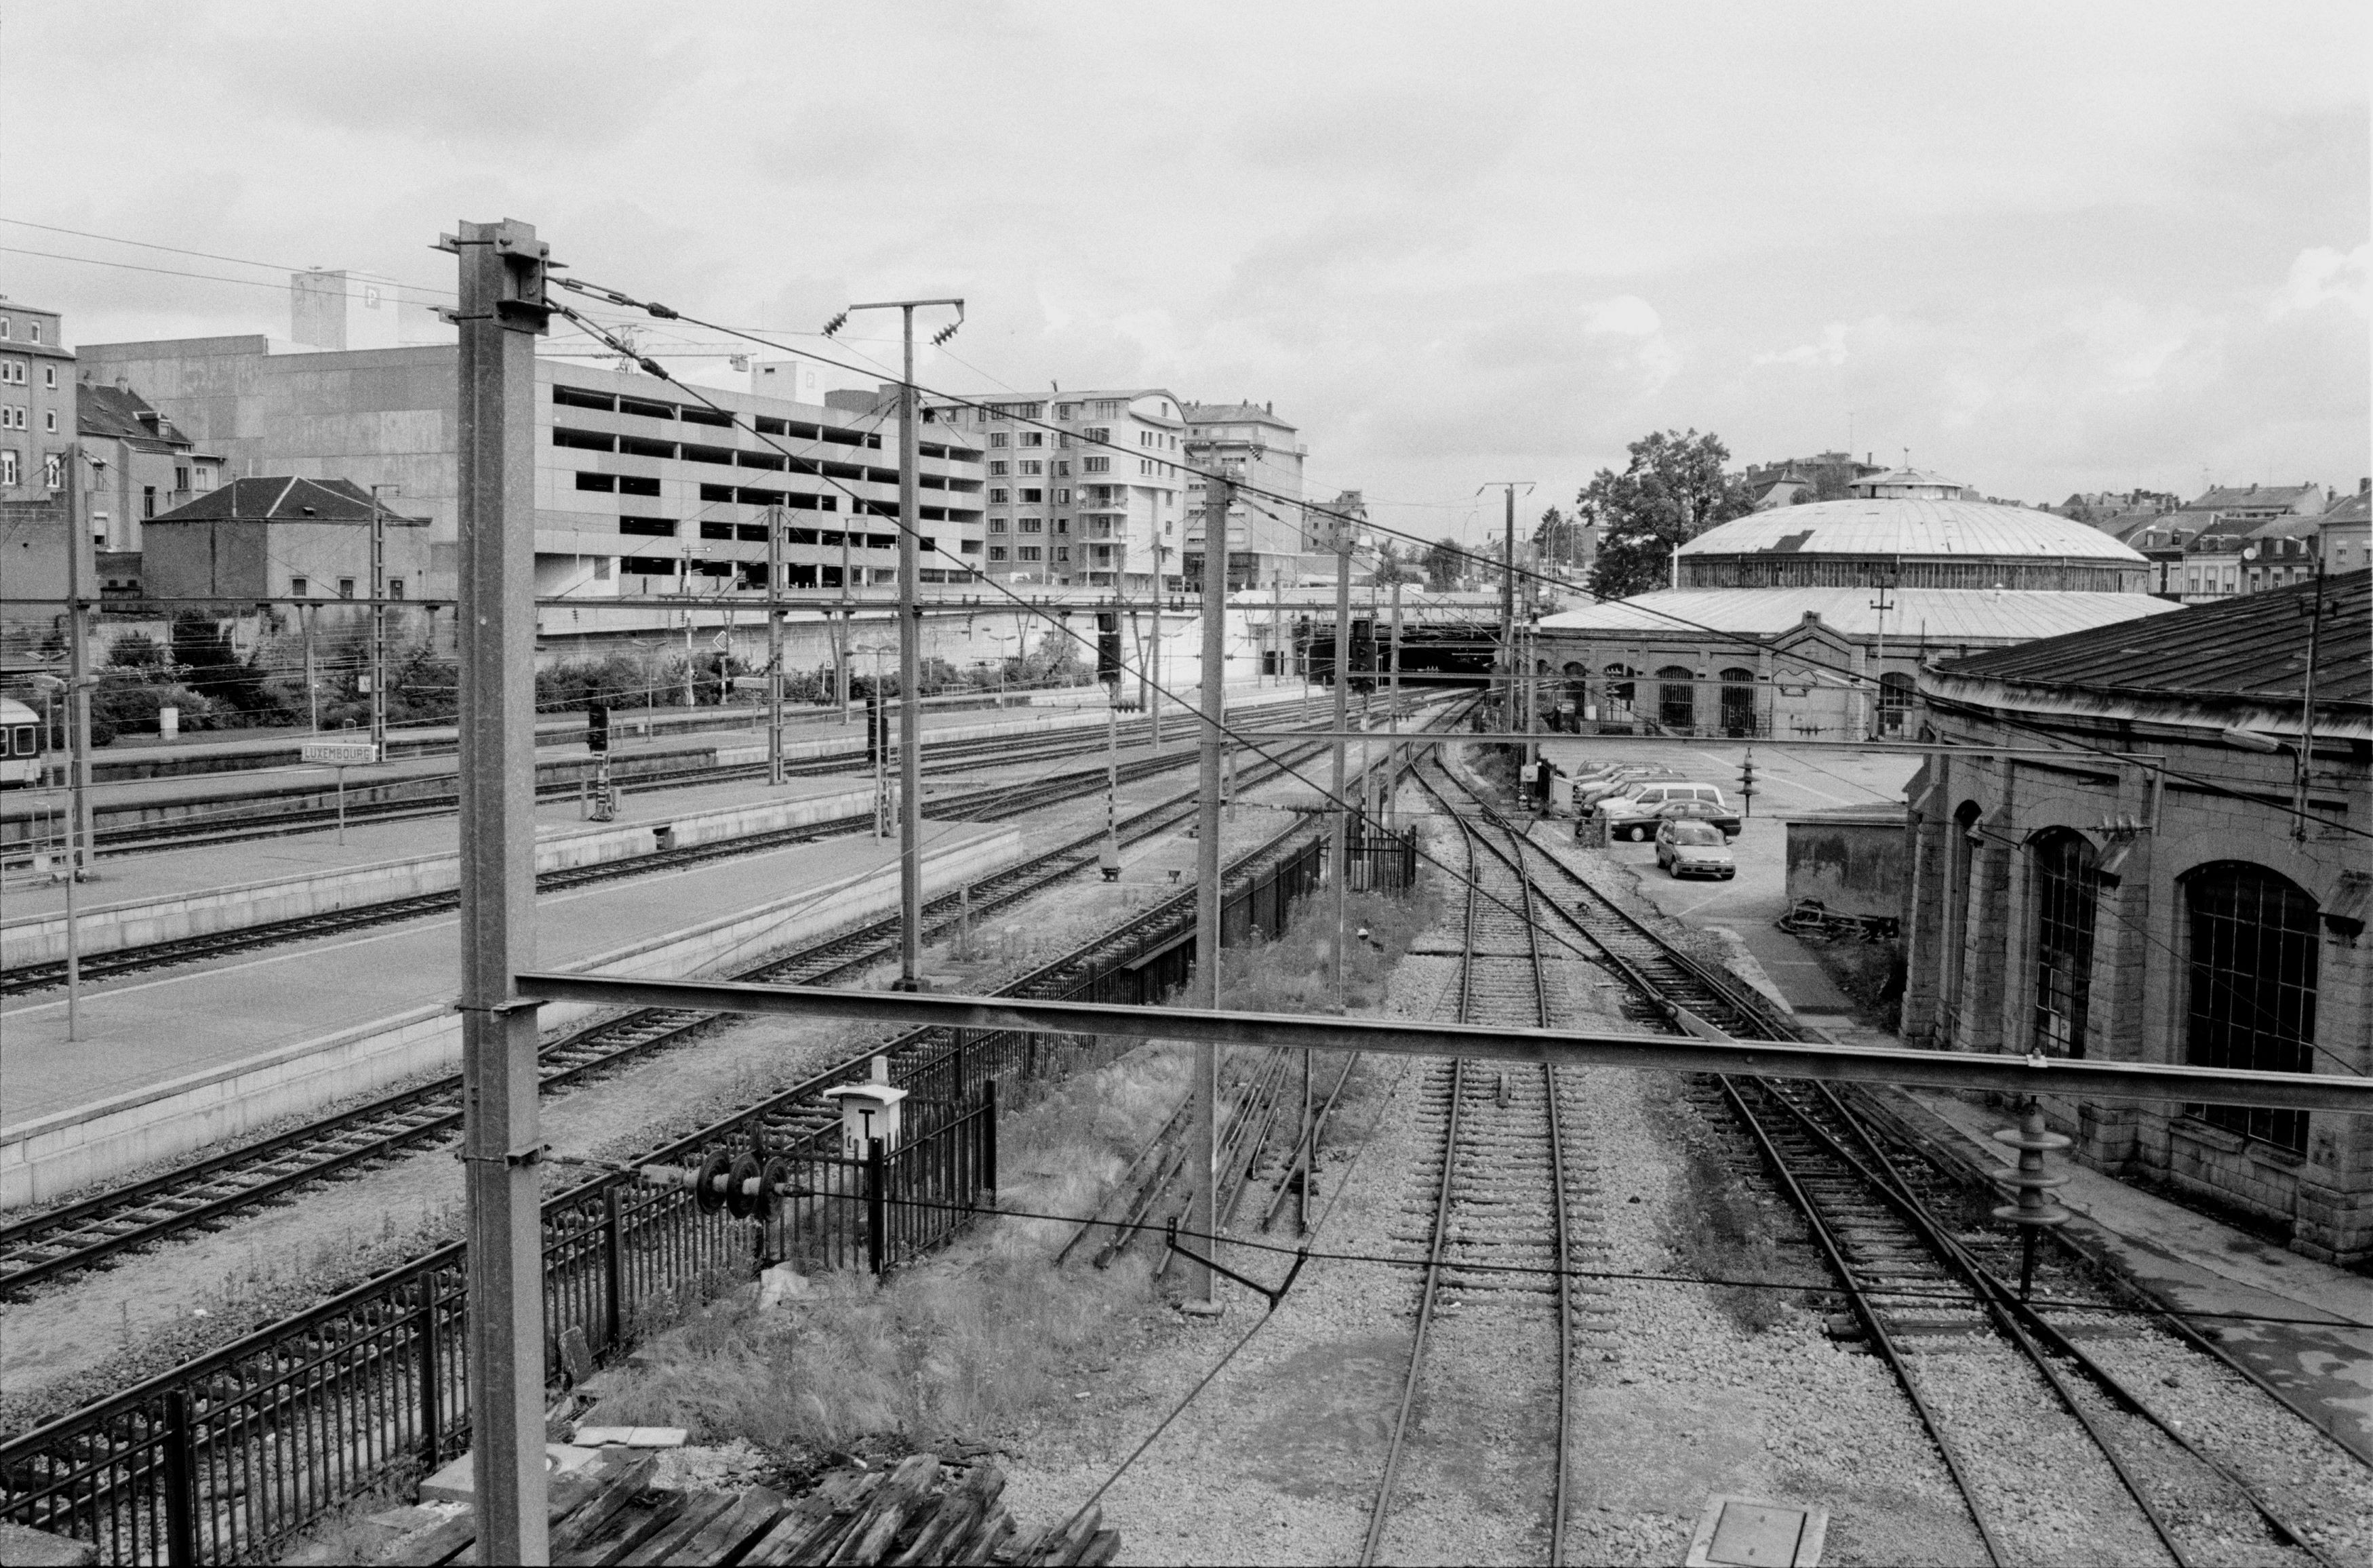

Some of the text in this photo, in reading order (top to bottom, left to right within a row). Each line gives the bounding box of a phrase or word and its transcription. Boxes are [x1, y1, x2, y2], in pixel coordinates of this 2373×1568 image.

[367, 289, 377, 305] P
[304, 747, 370, 760] LUXEMBOURG
[858, 1109, 875, 1140] T
